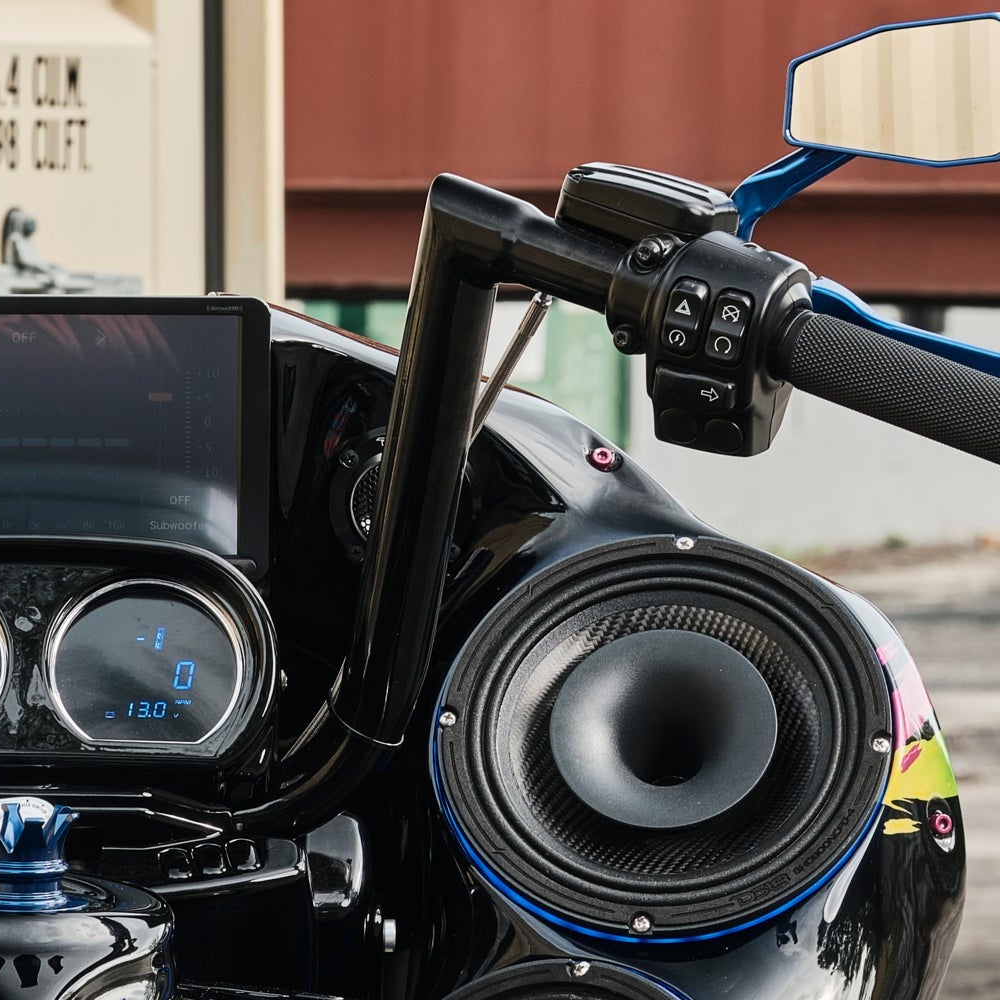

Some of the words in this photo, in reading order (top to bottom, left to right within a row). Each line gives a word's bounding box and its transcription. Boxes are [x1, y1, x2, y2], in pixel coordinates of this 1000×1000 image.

[11, 331, 38, 344] OFF
[169, 495, 191, 505] OFF
[173, 660, 195, 690] 0
[128, 701, 166, 718] 13.0
